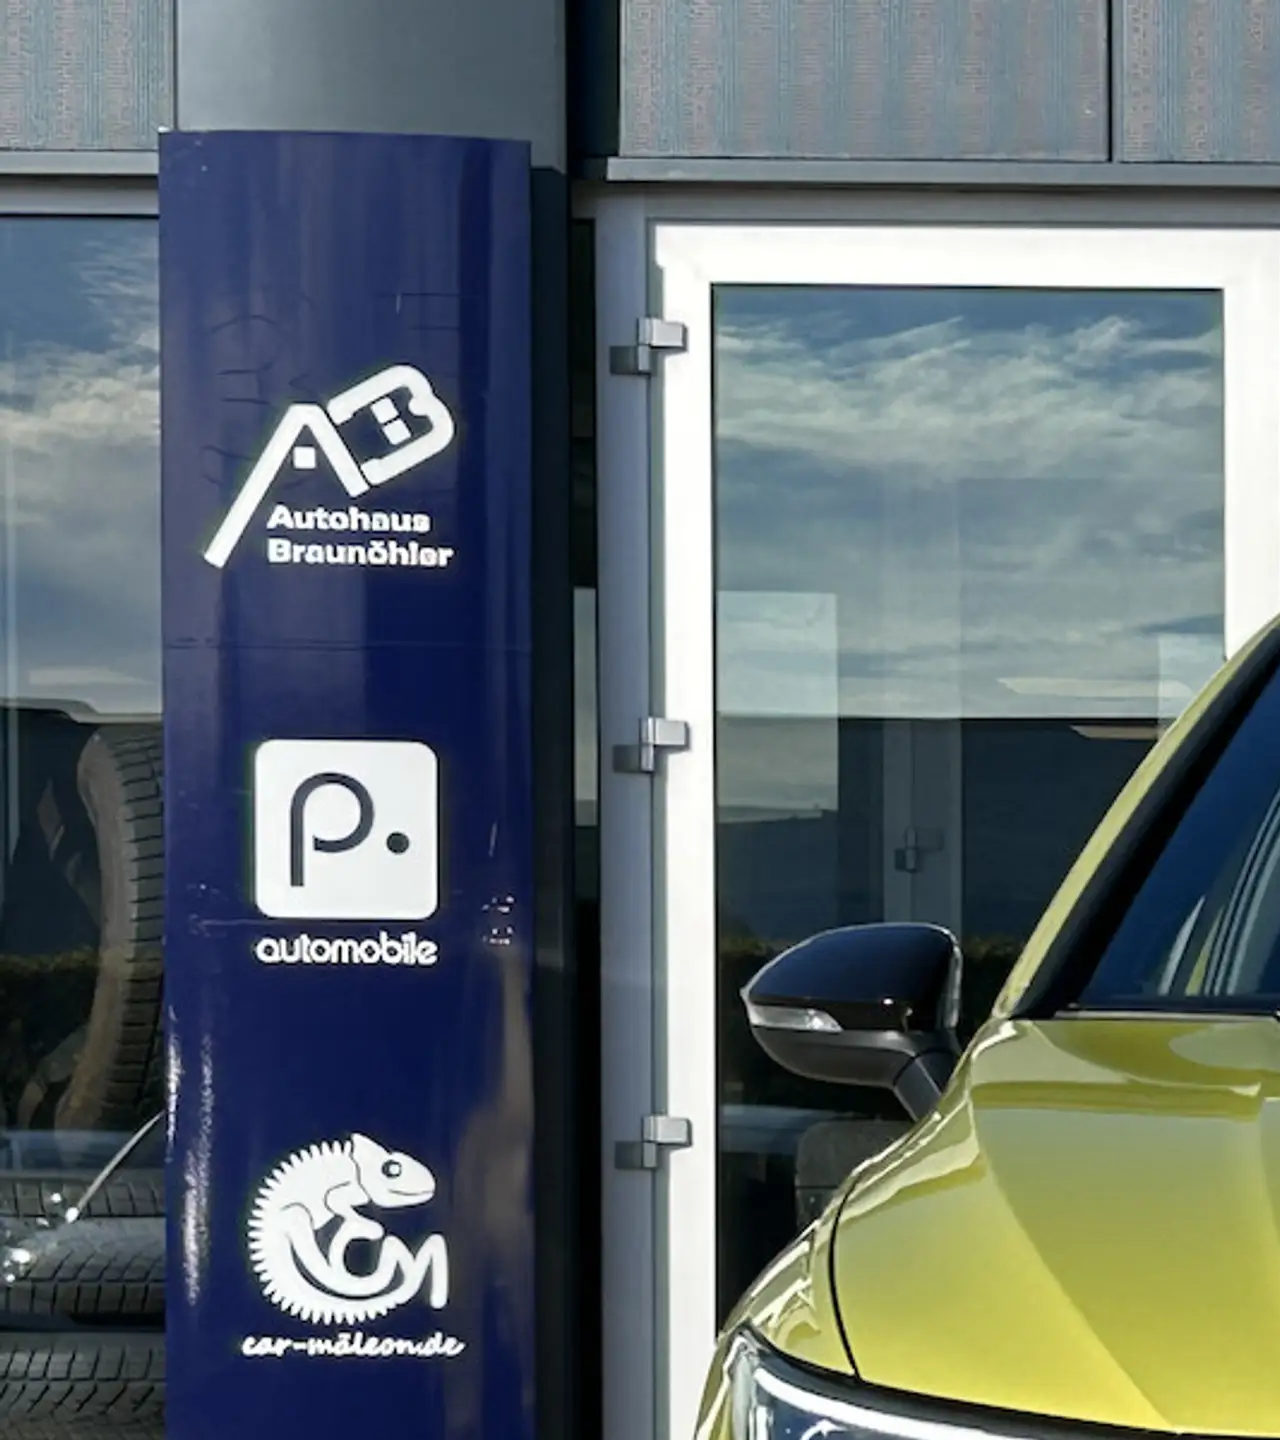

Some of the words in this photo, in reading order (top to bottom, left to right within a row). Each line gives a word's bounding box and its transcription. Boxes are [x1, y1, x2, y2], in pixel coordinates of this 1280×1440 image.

[266, 504, 431, 533] Autohaus
[267, 538, 454, 567] Braunöhler
[255, 930, 439, 965] automobile
